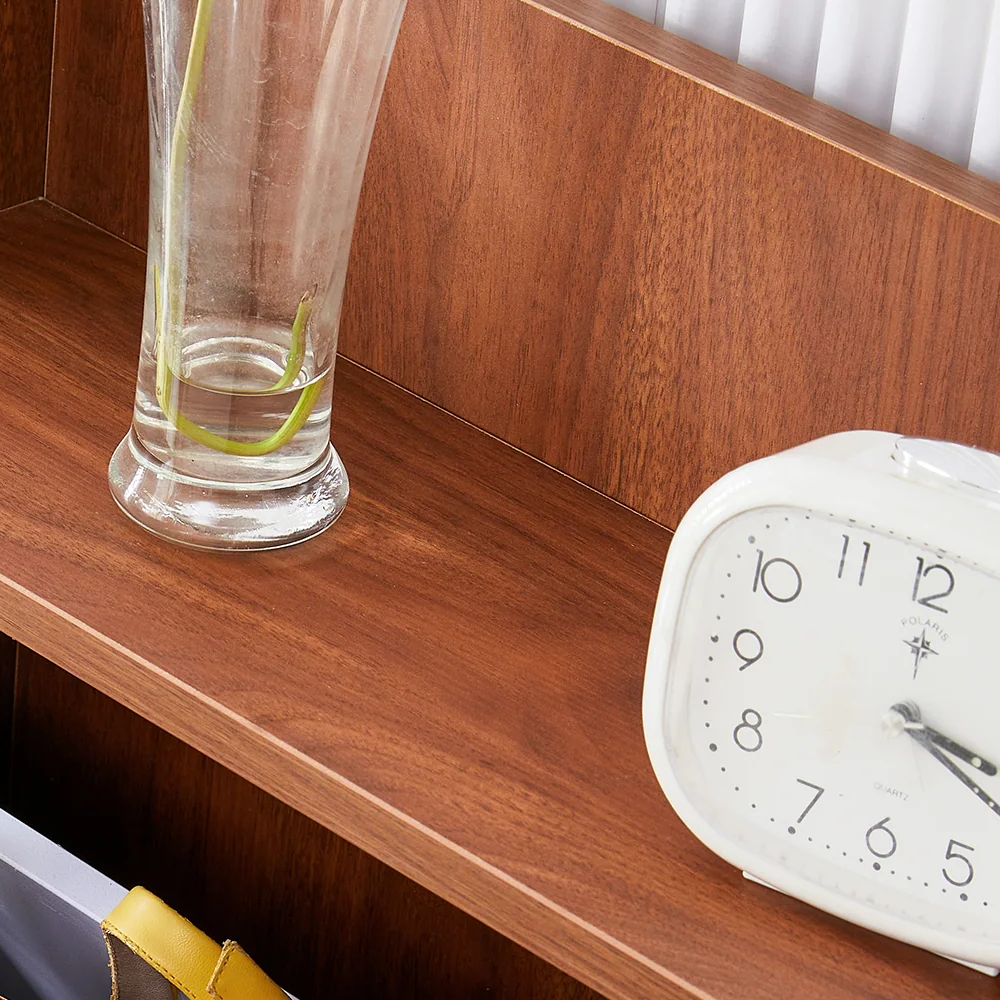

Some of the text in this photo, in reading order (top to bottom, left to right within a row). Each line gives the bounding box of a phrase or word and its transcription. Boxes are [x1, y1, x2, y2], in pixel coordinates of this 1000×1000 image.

[752, 548, 802, 603] 10
[837, 534, 871, 586] 11
[911, 556, 955, 613] 12
[733, 628, 764, 672] 9
[900, 616, 949, 641] POLARIS
[733, 708, 763, 752] 8
[796, 778, 825, 824] 7
[873, 782, 910, 801] QUARTZ
[865, 817, 897, 859] 6
[941, 839, 975, 887] 5
